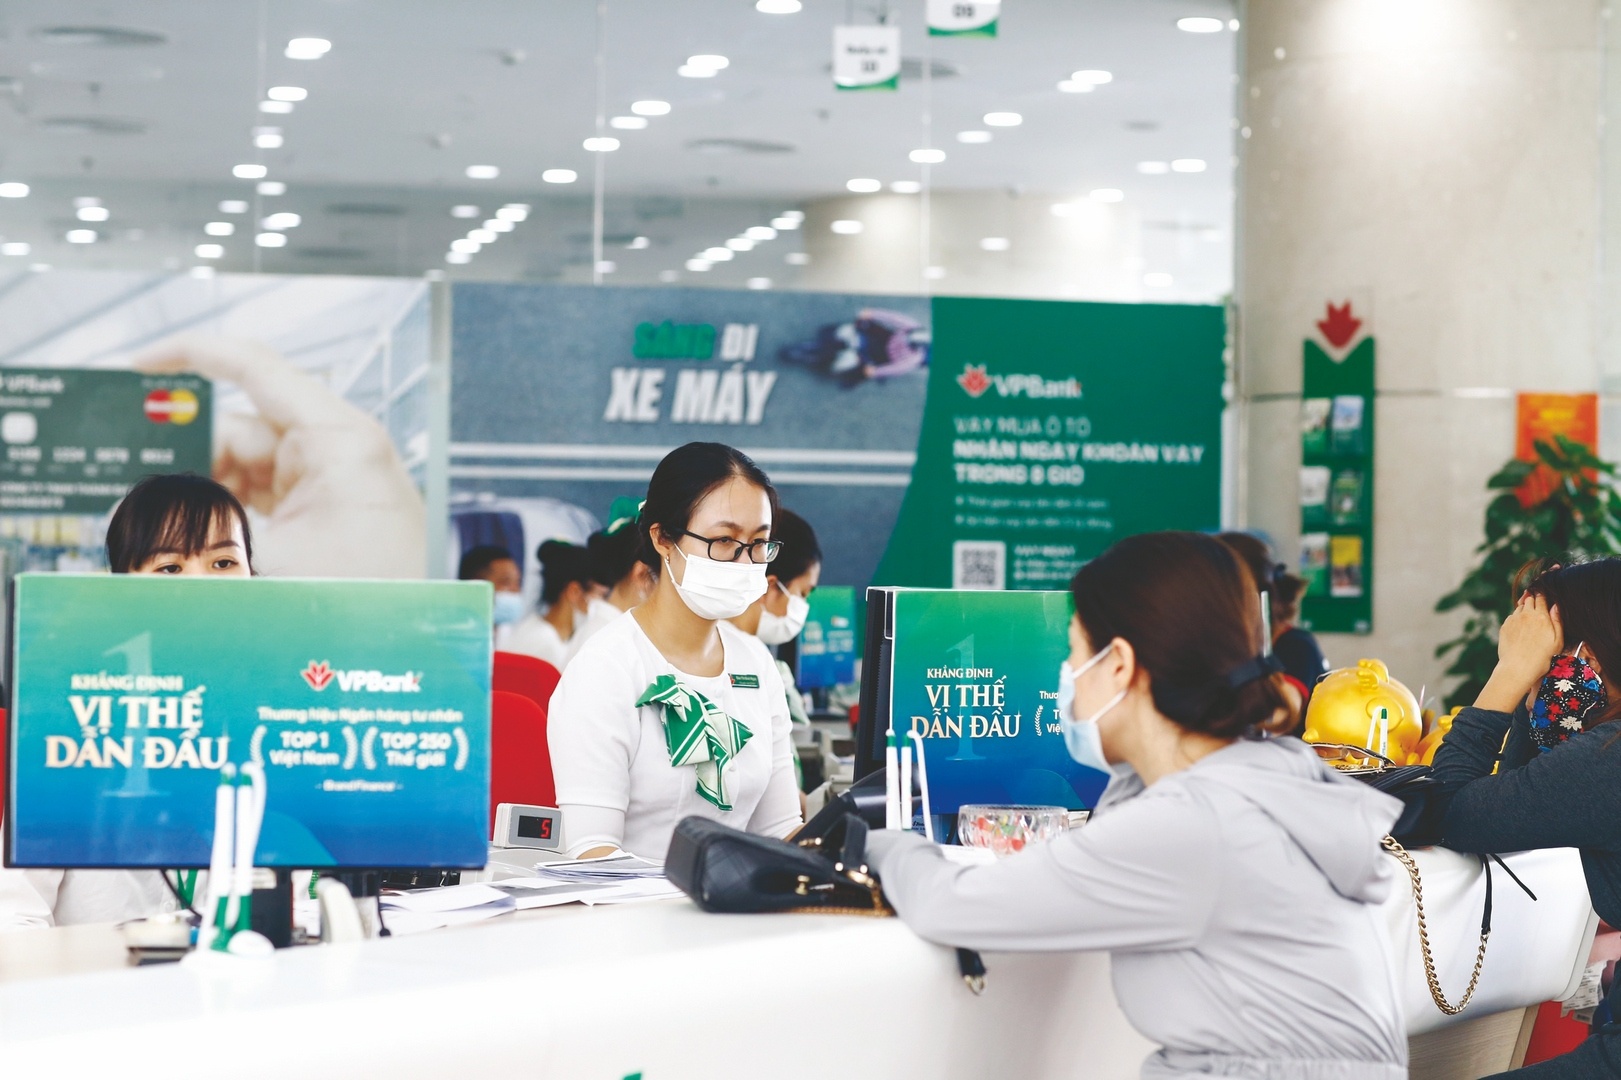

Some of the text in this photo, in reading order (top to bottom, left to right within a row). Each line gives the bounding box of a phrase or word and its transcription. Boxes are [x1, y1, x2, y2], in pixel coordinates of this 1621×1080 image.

[603, 362, 779, 425] XE MÁY
[993, 373, 1083, 400] VPBank
[954, 416, 993, 434] VAY
[997, 416, 1042, 435] MUA
[1020, 440, 1080, 461] NGAY
[1161, 444, 1204, 463] VAY
[954, 463, 1028, 484] TRONG
[337, 669, 423, 692] VPBank
[966, 668, 993, 680] ĐỊNH
[925, 675, 1007, 712] VỊ THẾ
[68, 685, 206, 735] VỊ THẾ
[911, 705, 1021, 739] DẪN ĐẦU
[44, 726, 230, 769] DẪN ĐẦU
[280, 731, 329, 749] TOP 1
[380, 731, 452, 750] TOP 250
[270, 749, 340, 769] Việt Nam
[541, 819, 551, 838] 5
